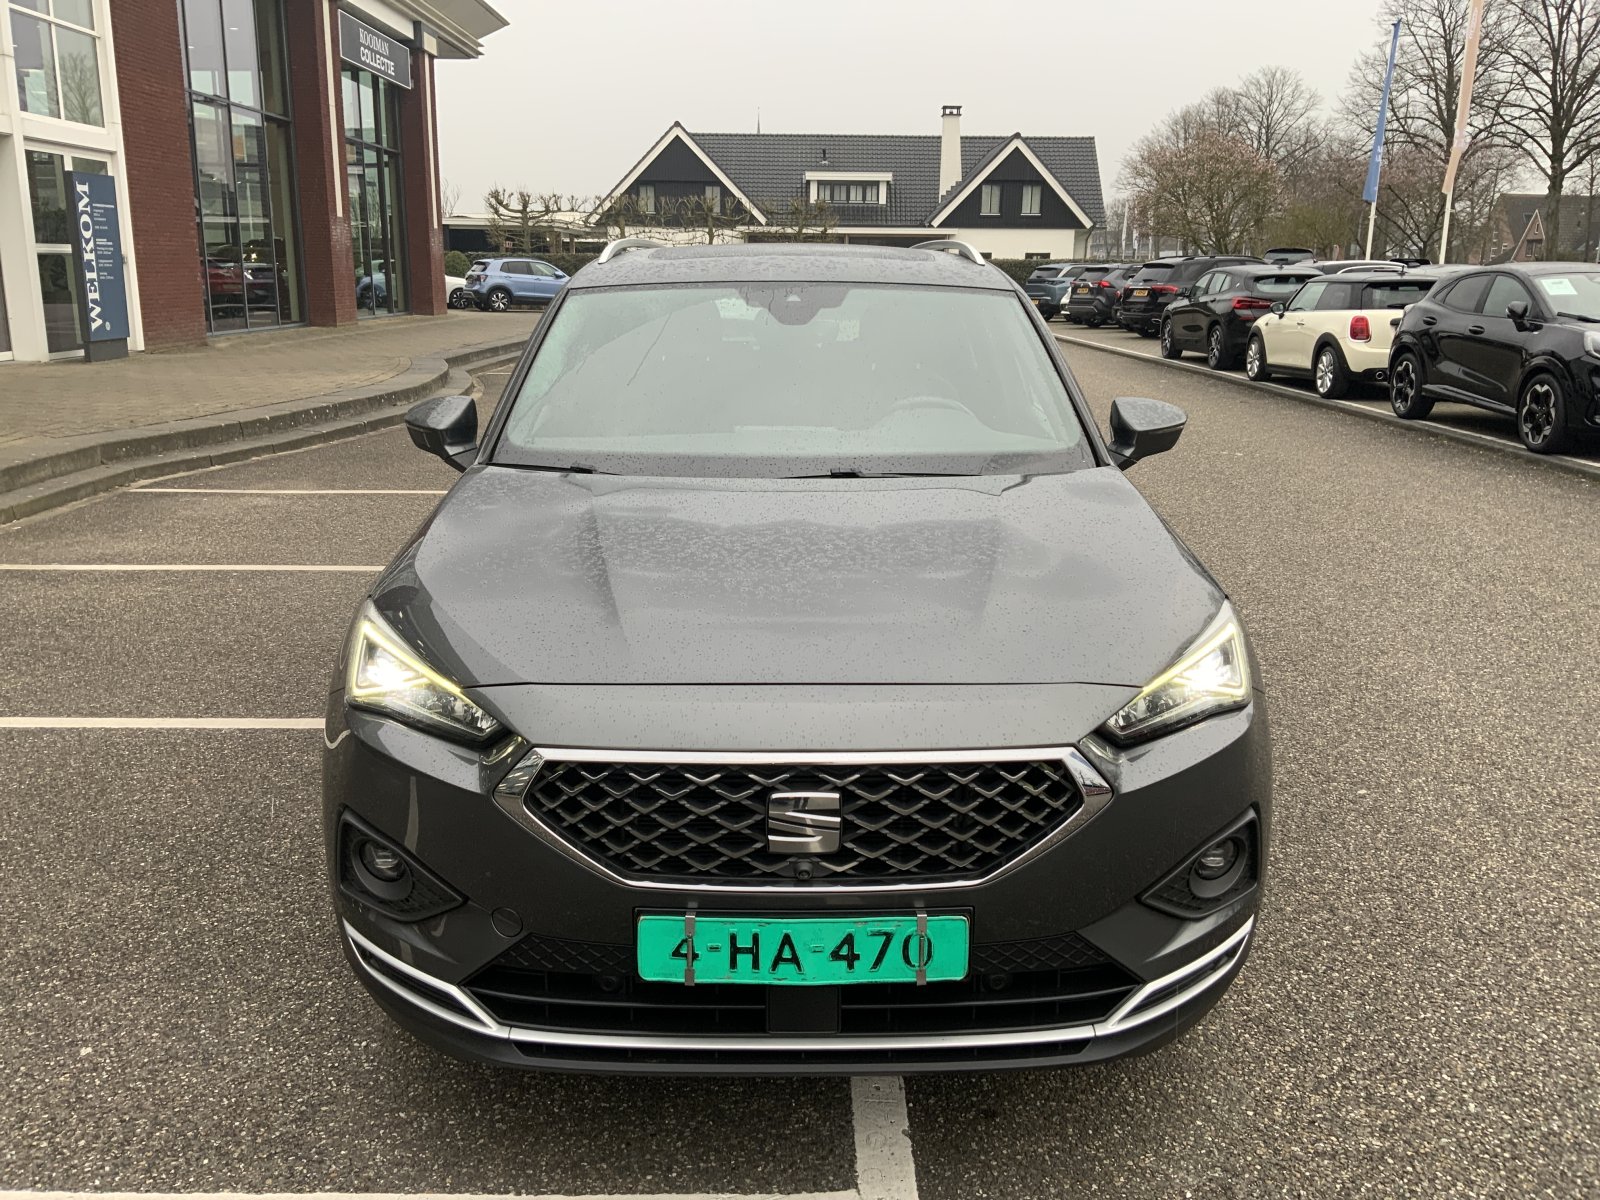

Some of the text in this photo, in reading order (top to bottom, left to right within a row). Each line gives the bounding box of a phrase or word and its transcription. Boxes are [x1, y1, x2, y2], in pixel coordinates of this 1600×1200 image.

[359, 28, 389, 56] KOOIMAN
[360, 47, 395, 76] COLLECTIE
[76, 181, 103, 332] WELKOM
[669, 930, 933, 974] 4-HA-470
